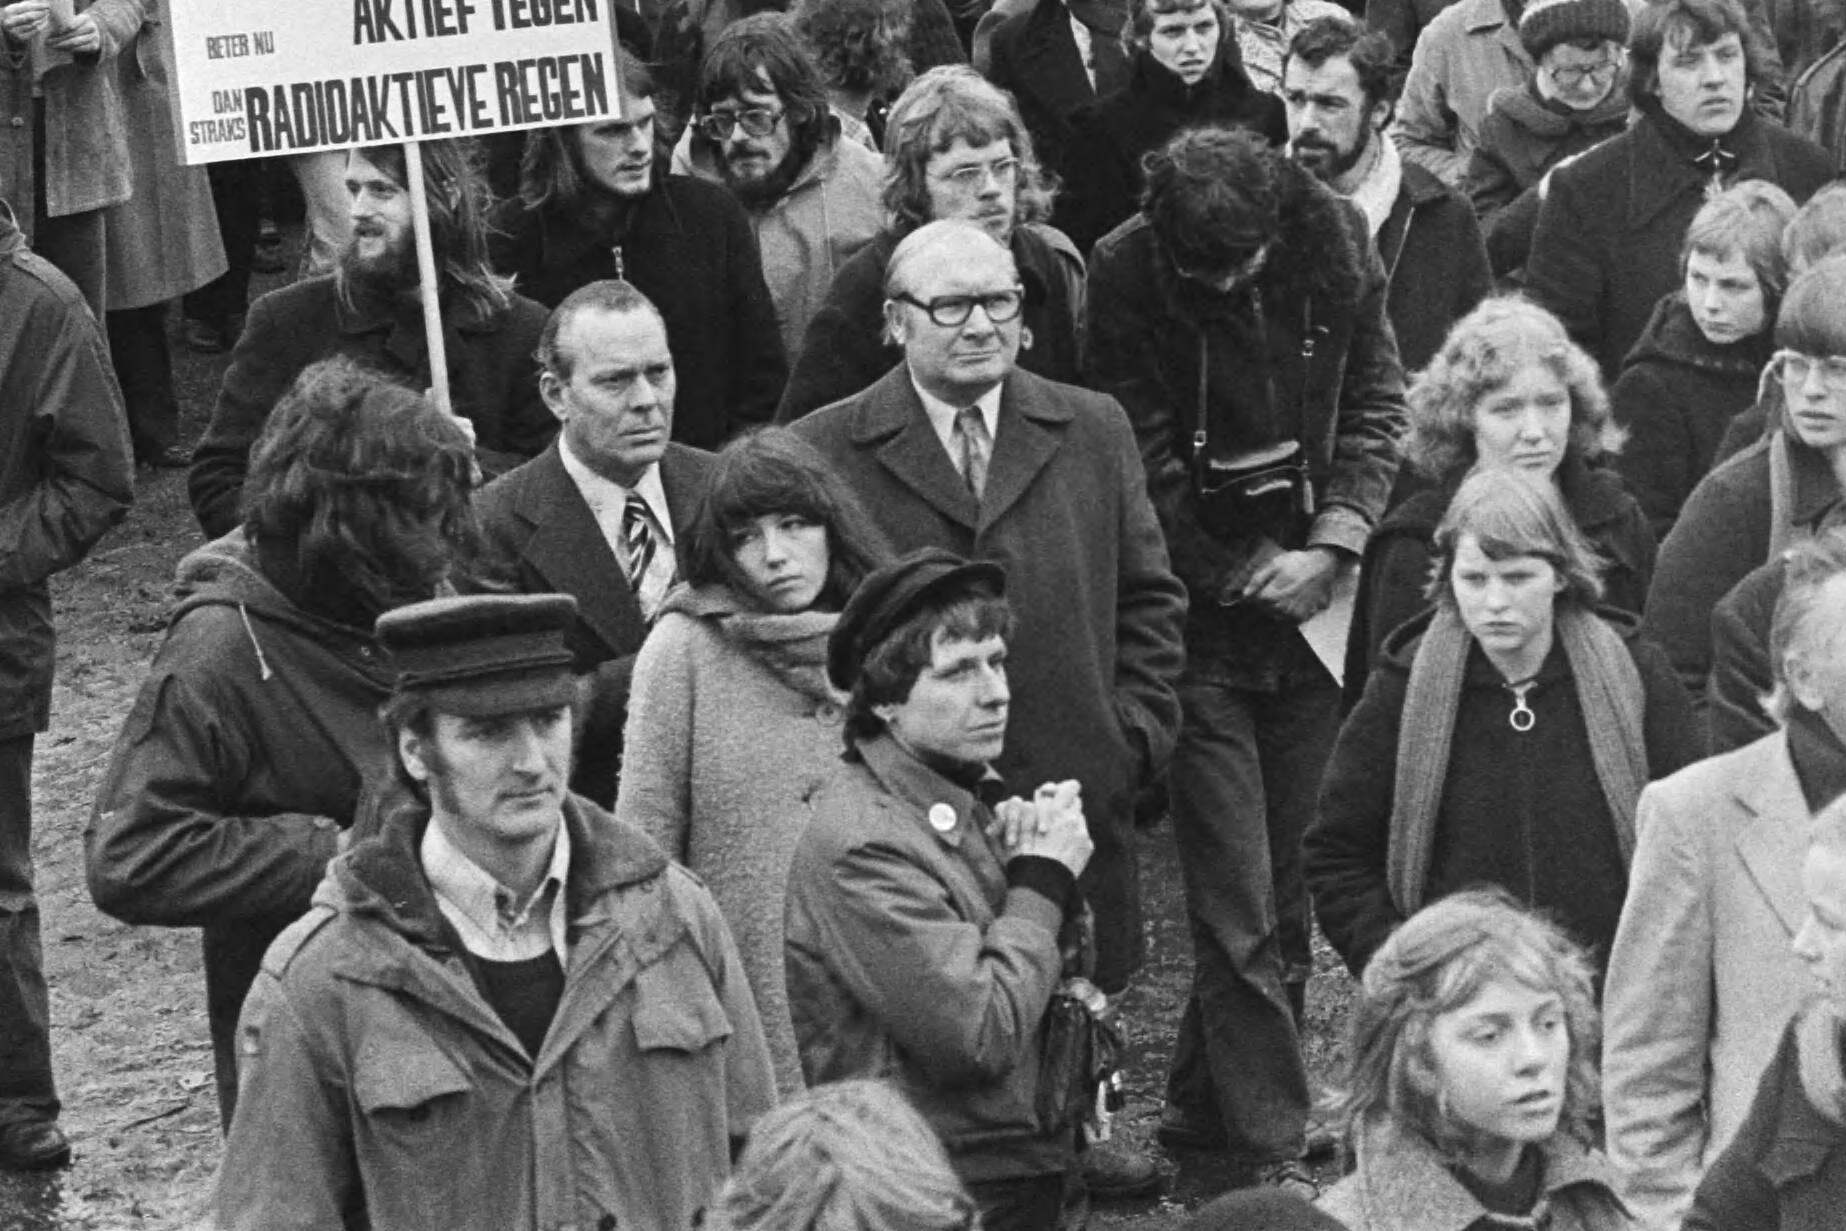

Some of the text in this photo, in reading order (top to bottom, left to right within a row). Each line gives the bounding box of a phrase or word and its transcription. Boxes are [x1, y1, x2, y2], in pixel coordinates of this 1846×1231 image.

[206, 31, 275, 59] BETER NU
[212, 89, 243, 114] DAN
[244, 51, 609, 153] RADIOAKTIEVE REGEN
[189, 117, 247, 145] STRAKS
